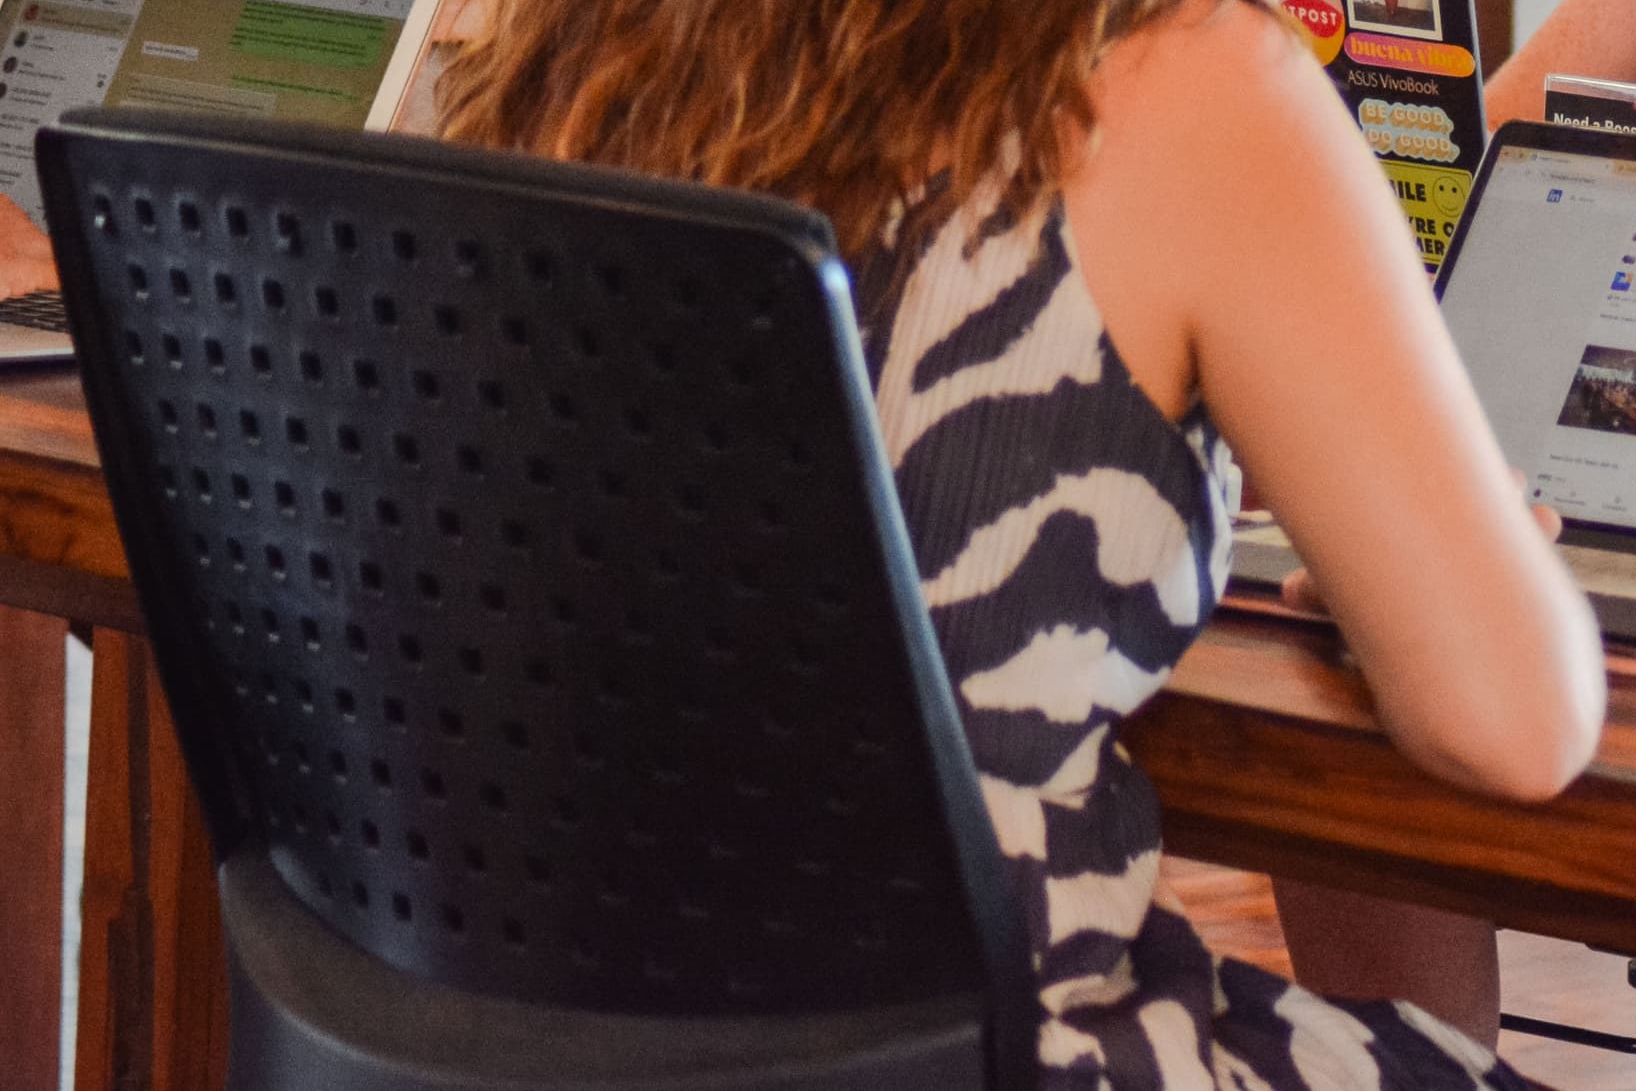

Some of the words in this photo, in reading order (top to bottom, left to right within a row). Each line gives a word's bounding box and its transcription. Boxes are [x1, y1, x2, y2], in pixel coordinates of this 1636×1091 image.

[1282, 5, 1338, 26] TPOST
[1350, 36, 1414, 63] buena
[1347, 70, 1379, 88] ASUS
[1379, 74, 1441, 96] VivoBook
[1365, 103, 1389, 119] BE
[1553, 112, 1589, 128] Need
[1367, 128, 1393, 144] DO
[1388, 179, 1427, 203] ILE
